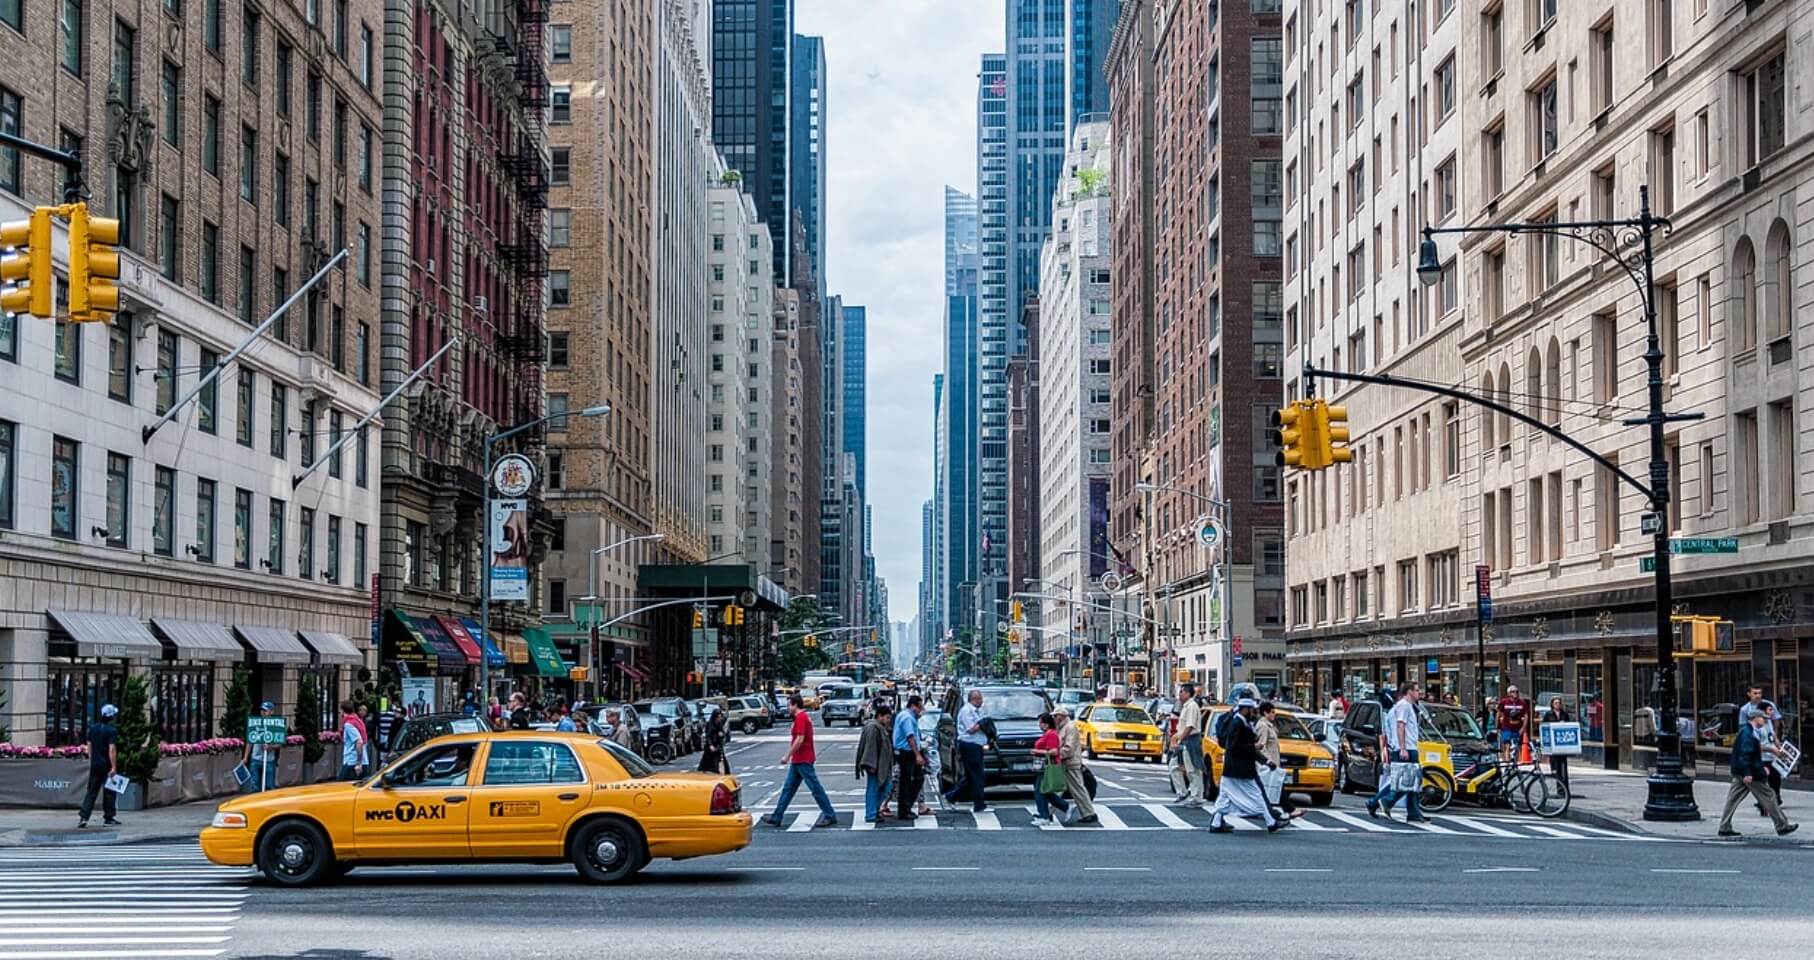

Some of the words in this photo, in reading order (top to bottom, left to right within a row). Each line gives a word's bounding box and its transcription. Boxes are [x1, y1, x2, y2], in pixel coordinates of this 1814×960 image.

[501, 502, 518, 510] NYC
[1682, 538, 1716, 549] CENTRAL
[1717, 538, 1737, 548] PARK
[248, 718, 262, 727] BIKE
[263, 718, 285, 728] RENTAL
[365, 810, 394, 821] NYC
[396, 802, 446, 822] TAXI
